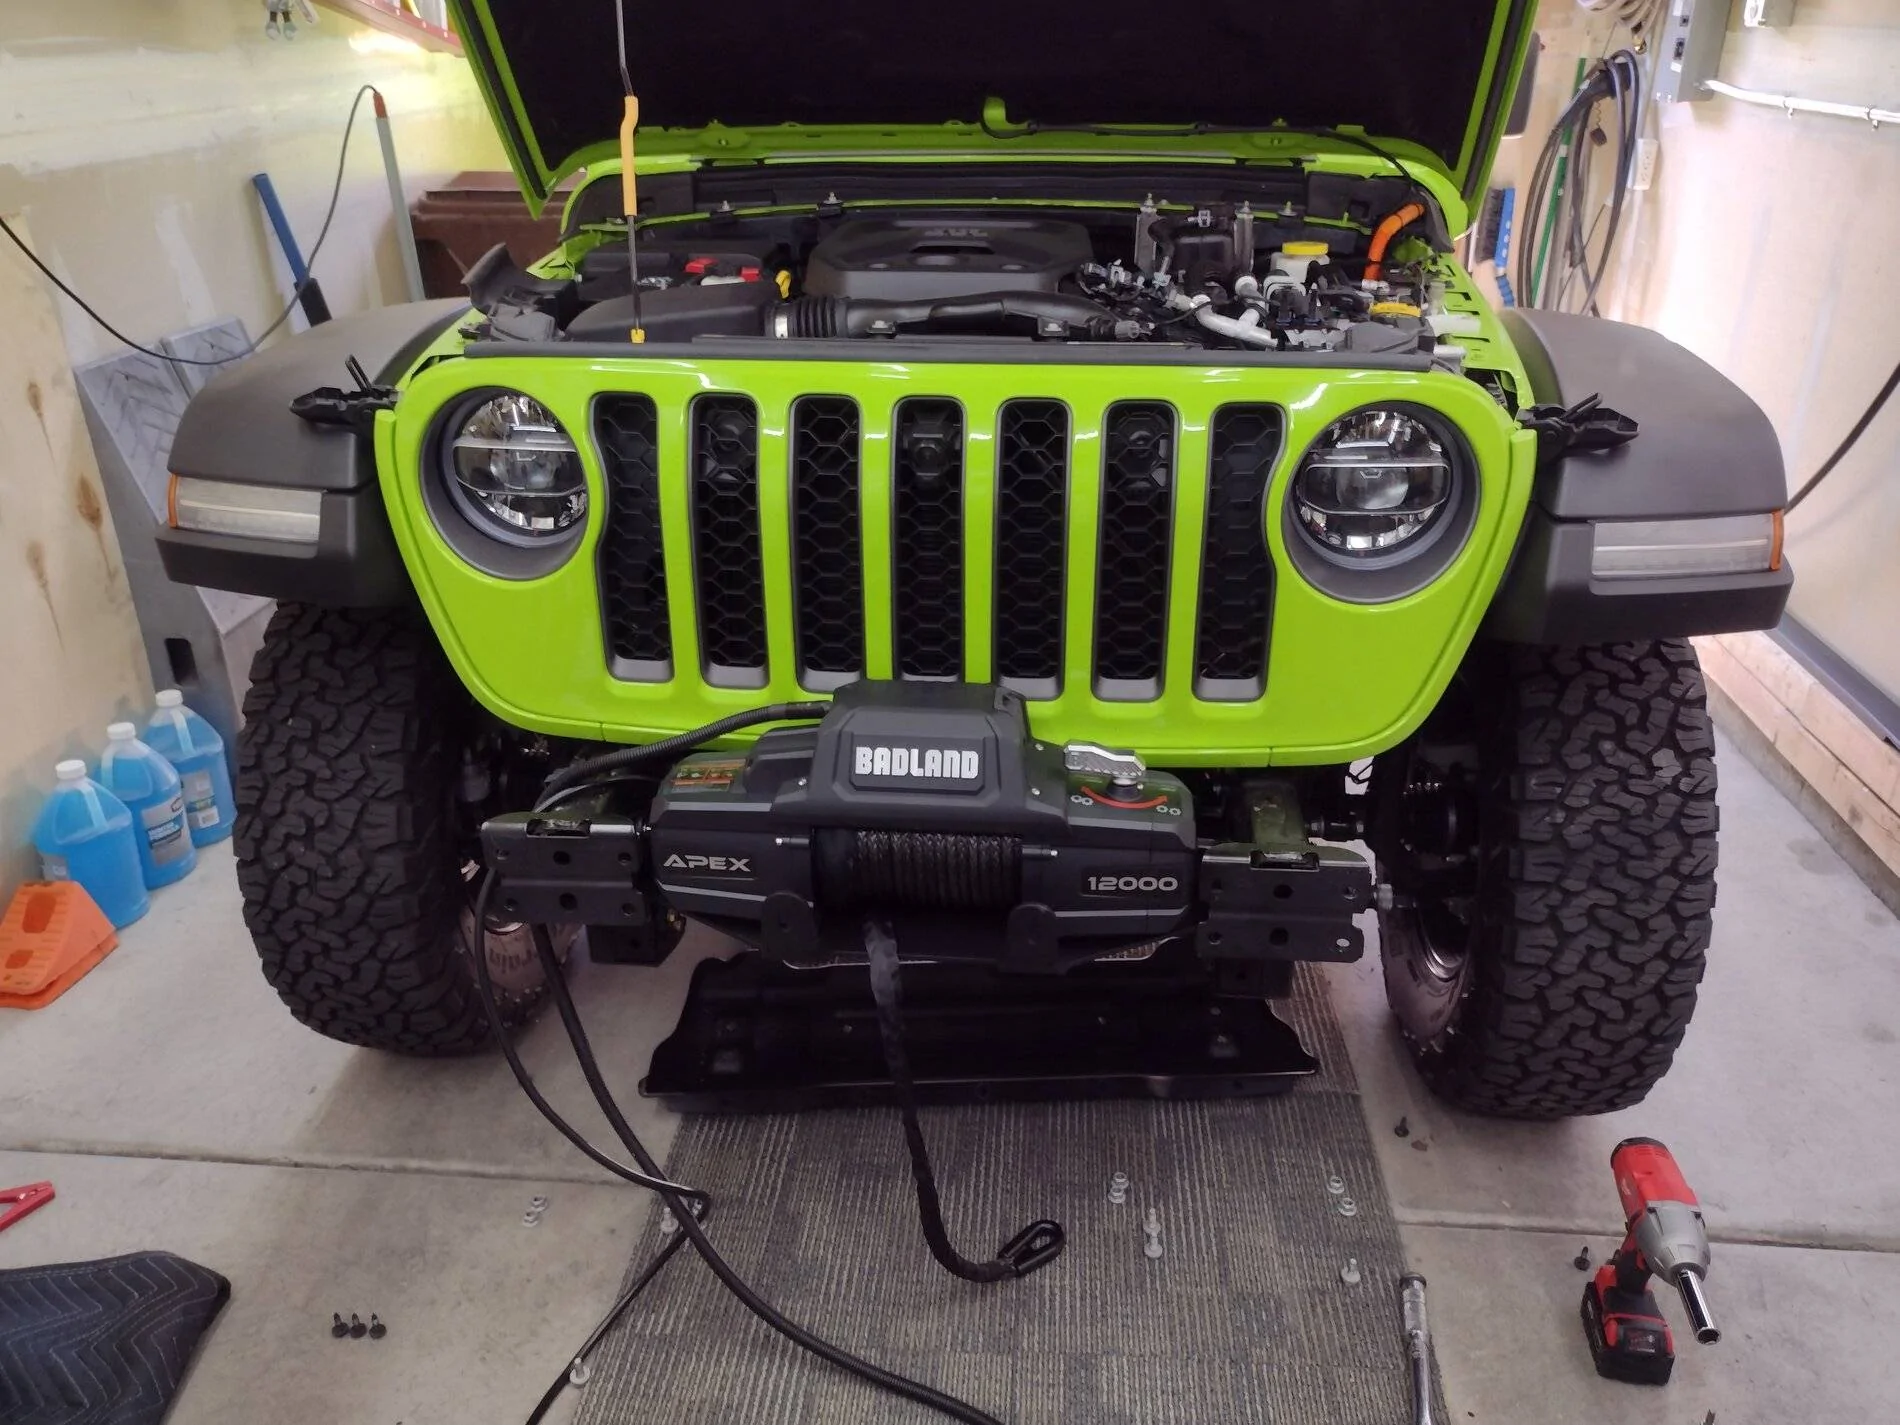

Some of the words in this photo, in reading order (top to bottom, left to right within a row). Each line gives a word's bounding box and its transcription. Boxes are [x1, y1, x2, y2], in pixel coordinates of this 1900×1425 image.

[855, 747, 979, 779] BADLAND
[663, 854, 751, 872] APEX
[1088, 877, 1179, 891] 12000
